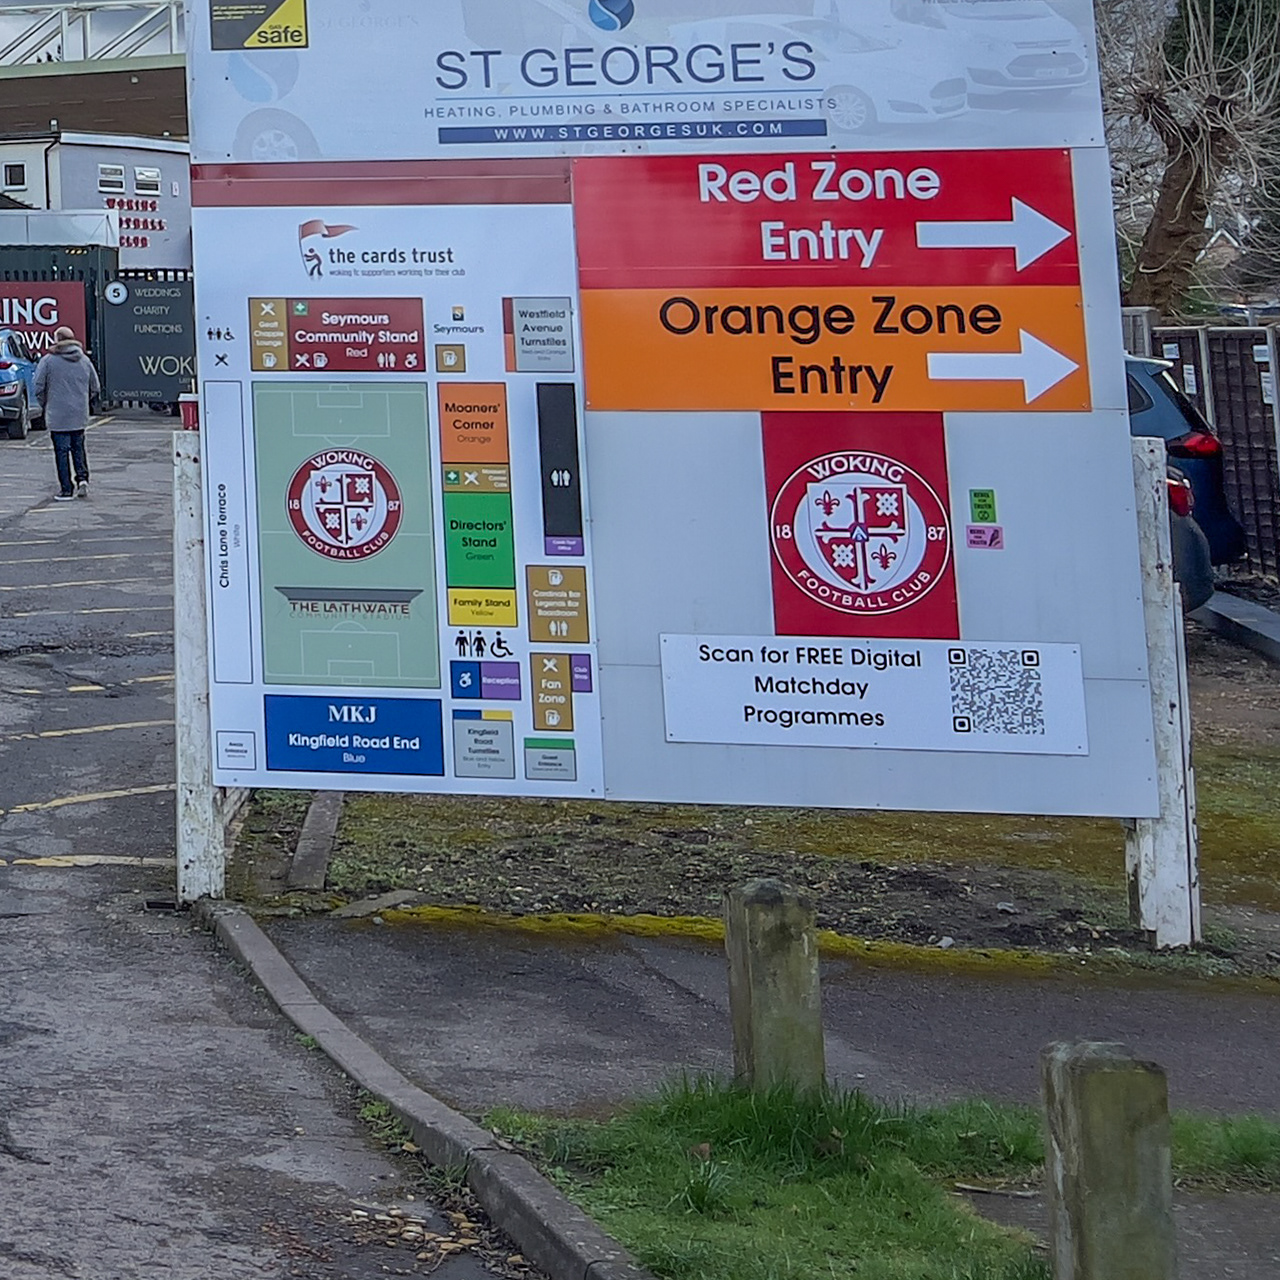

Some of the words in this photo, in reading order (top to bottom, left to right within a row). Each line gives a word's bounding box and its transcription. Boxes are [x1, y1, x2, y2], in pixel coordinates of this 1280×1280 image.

[257, 26, 302, 43] safe
[436, 50, 502, 89] ST
[520, 41, 816, 87] GEORGE'S
[424, 105, 501, 118] HEATING,
[509, 104, 595, 116] PLUMBING
[603, 104, 612, 114] &
[621, 101, 715, 114] BATHROOM
[723, 98, 837, 111] SPECIALISTS
[494, 123, 782, 140] WWW.STGEORGESUK.COM
[698, 162, 797, 203] Red
[810, 161, 940, 202] Zone
[104, 198, 159, 211] WOKING
[760, 220, 884, 268] Entry
[329, 248, 355, 263] the
[361, 248, 406, 263] cards
[412, 248, 454, 263] trust
[112, 288, 121, 298] 5
[135, 288, 181, 297] WEDDINGS
[133, 306, 170, 315] CHARITY
[518, 310, 565, 319] Westfield
[322, 312, 389, 327] Seymours
[659, 296, 855, 345] Orange
[871, 296, 1002, 336] Zone
[134, 324, 182, 333] FUNCTIONS
[433, 324, 485, 335] Seymours
[522, 324, 563, 333] Avenue
[295, 330, 374, 345] Community
[378, 330, 418, 343] Stand
[520, 337, 567, 346] Turnstiles
[346, 347, 368, 358] Red
[772, 355, 894, 404] Entry
[445, 403, 500, 413] Moaners'
[452, 419, 494, 429] Corner
[457, 434, 491, 444] Orange
[311, 452, 374, 470] WOKING
[807, 456, 905, 481] WOKING
[289, 499, 300, 509] 18
[387, 501, 400, 511] 87
[450, 520, 506, 531] Directors'
[776, 525, 792, 539] 18
[927, 526, 946, 541] 87
[219, 529, 228, 556] Lane
[301, 530, 360, 557] FOOTBALL
[363, 531, 389, 553] CLUB
[462, 537, 497, 547] Stand
[465, 552, 494, 560] Green
[219, 560, 229, 588] Chris
[798, 570, 888, 607] FOOTBALL
[892, 571, 931, 602] CLUB
[290, 602, 319, 612] THE
[324, 602, 410, 614] LAITHWAITE
[454, 598, 482, 608] Family
[485, 599, 510, 607] Stand
[698, 644, 754, 664] Scan
[761, 645, 790, 665] for
[796, 647, 843, 666] FREE
[850, 648, 922, 673] Digital
[541, 679, 562, 688] Fan
[754, 676, 869, 700] Matchday
[538, 694, 566, 703] Zone
[328, 705, 377, 723] MKJ
[744, 705, 885, 728] Programmes
[289, 733, 349, 749] Kingfield
[353, 735, 389, 748] Road
[393, 737, 420, 749] End
[343, 752, 365, 763] Blue
